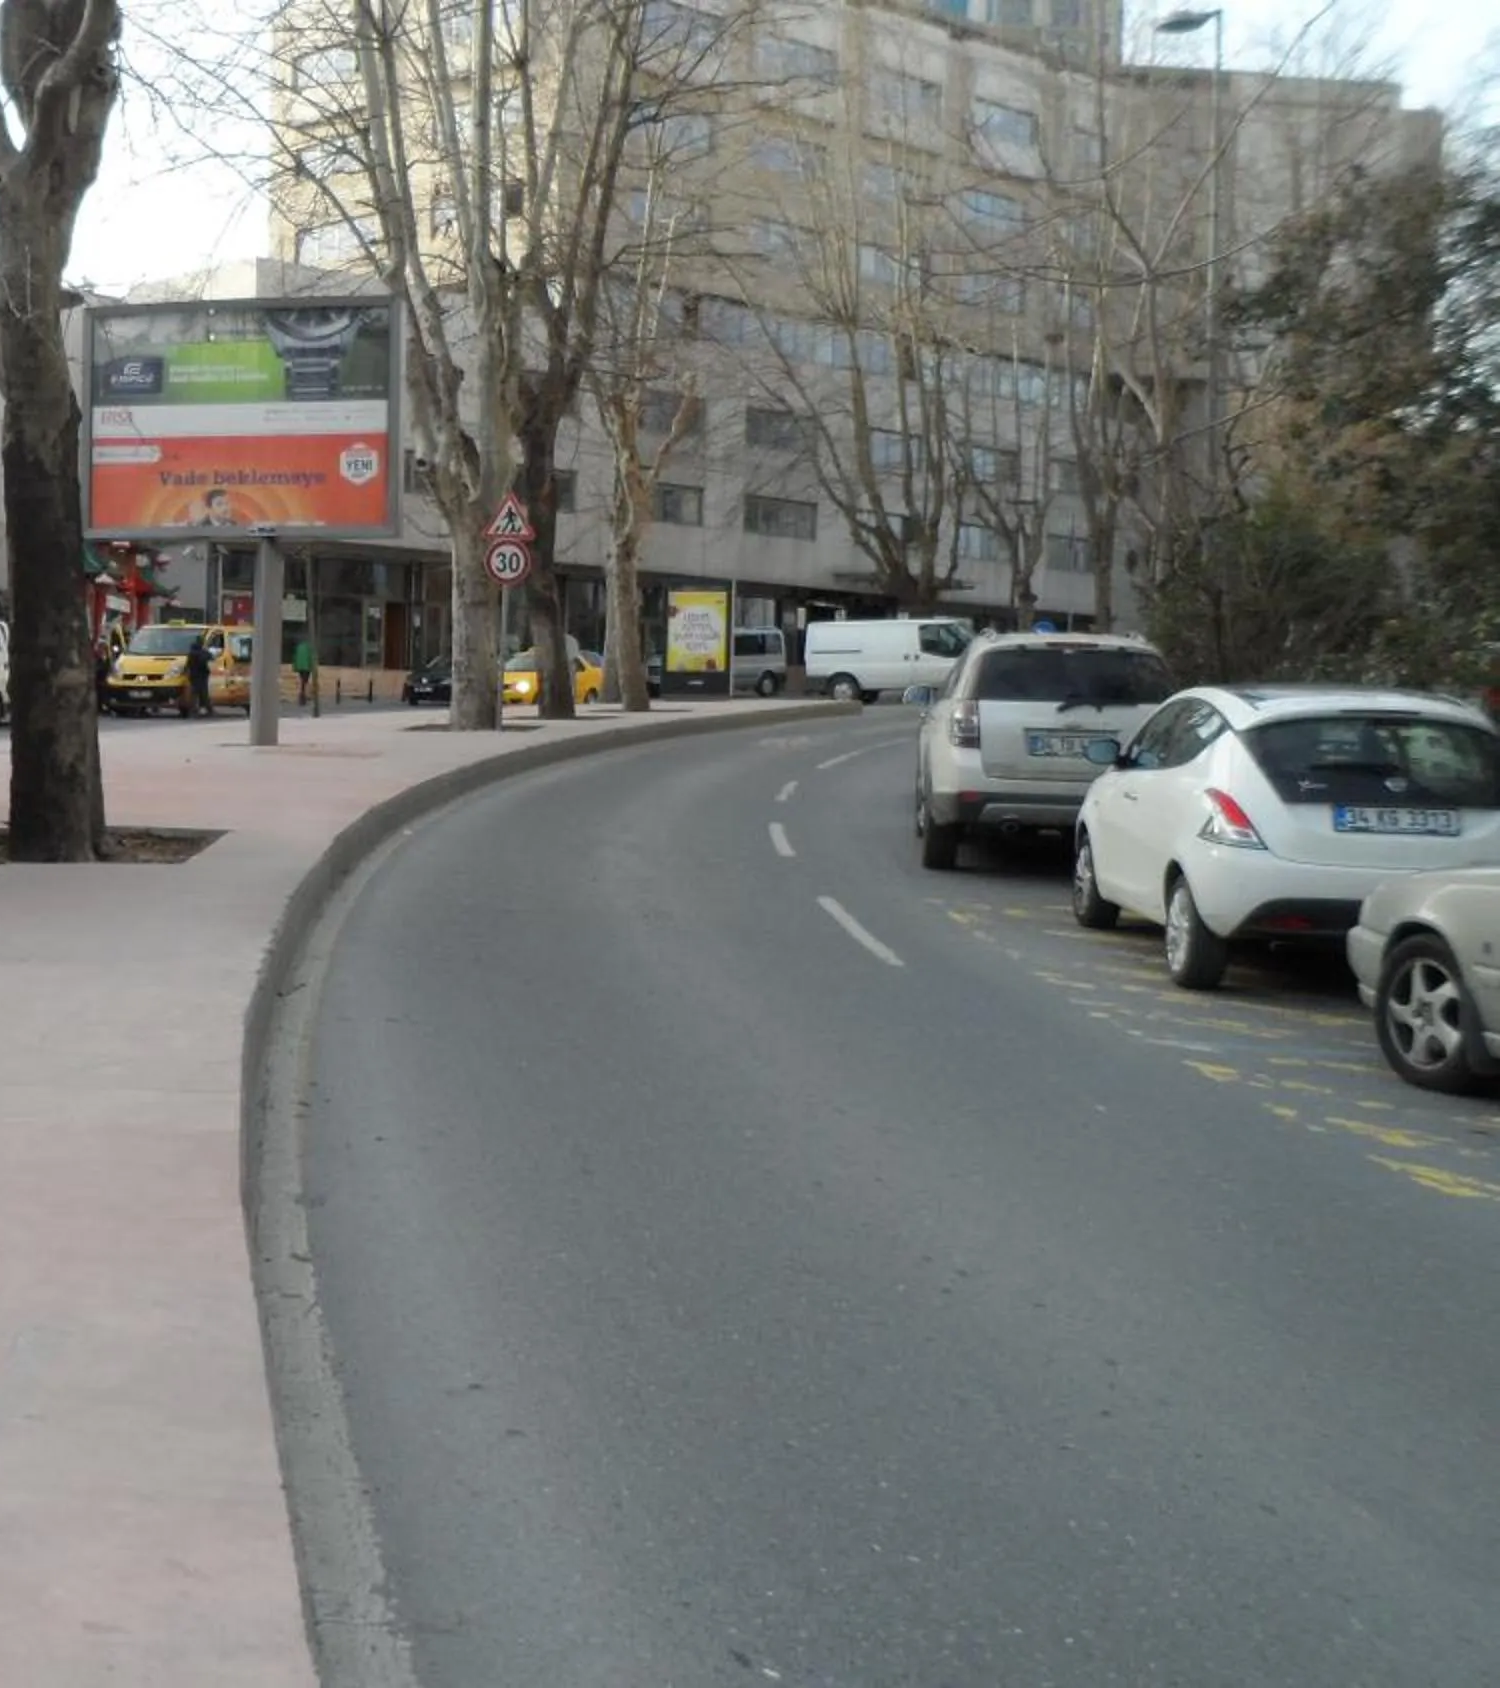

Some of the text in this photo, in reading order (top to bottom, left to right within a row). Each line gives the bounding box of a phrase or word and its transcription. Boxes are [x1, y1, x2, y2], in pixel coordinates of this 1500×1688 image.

[159, 470, 208, 487] Vade
[495, 551, 521, 573] 30
[1346, 809, 1370, 826] 34
